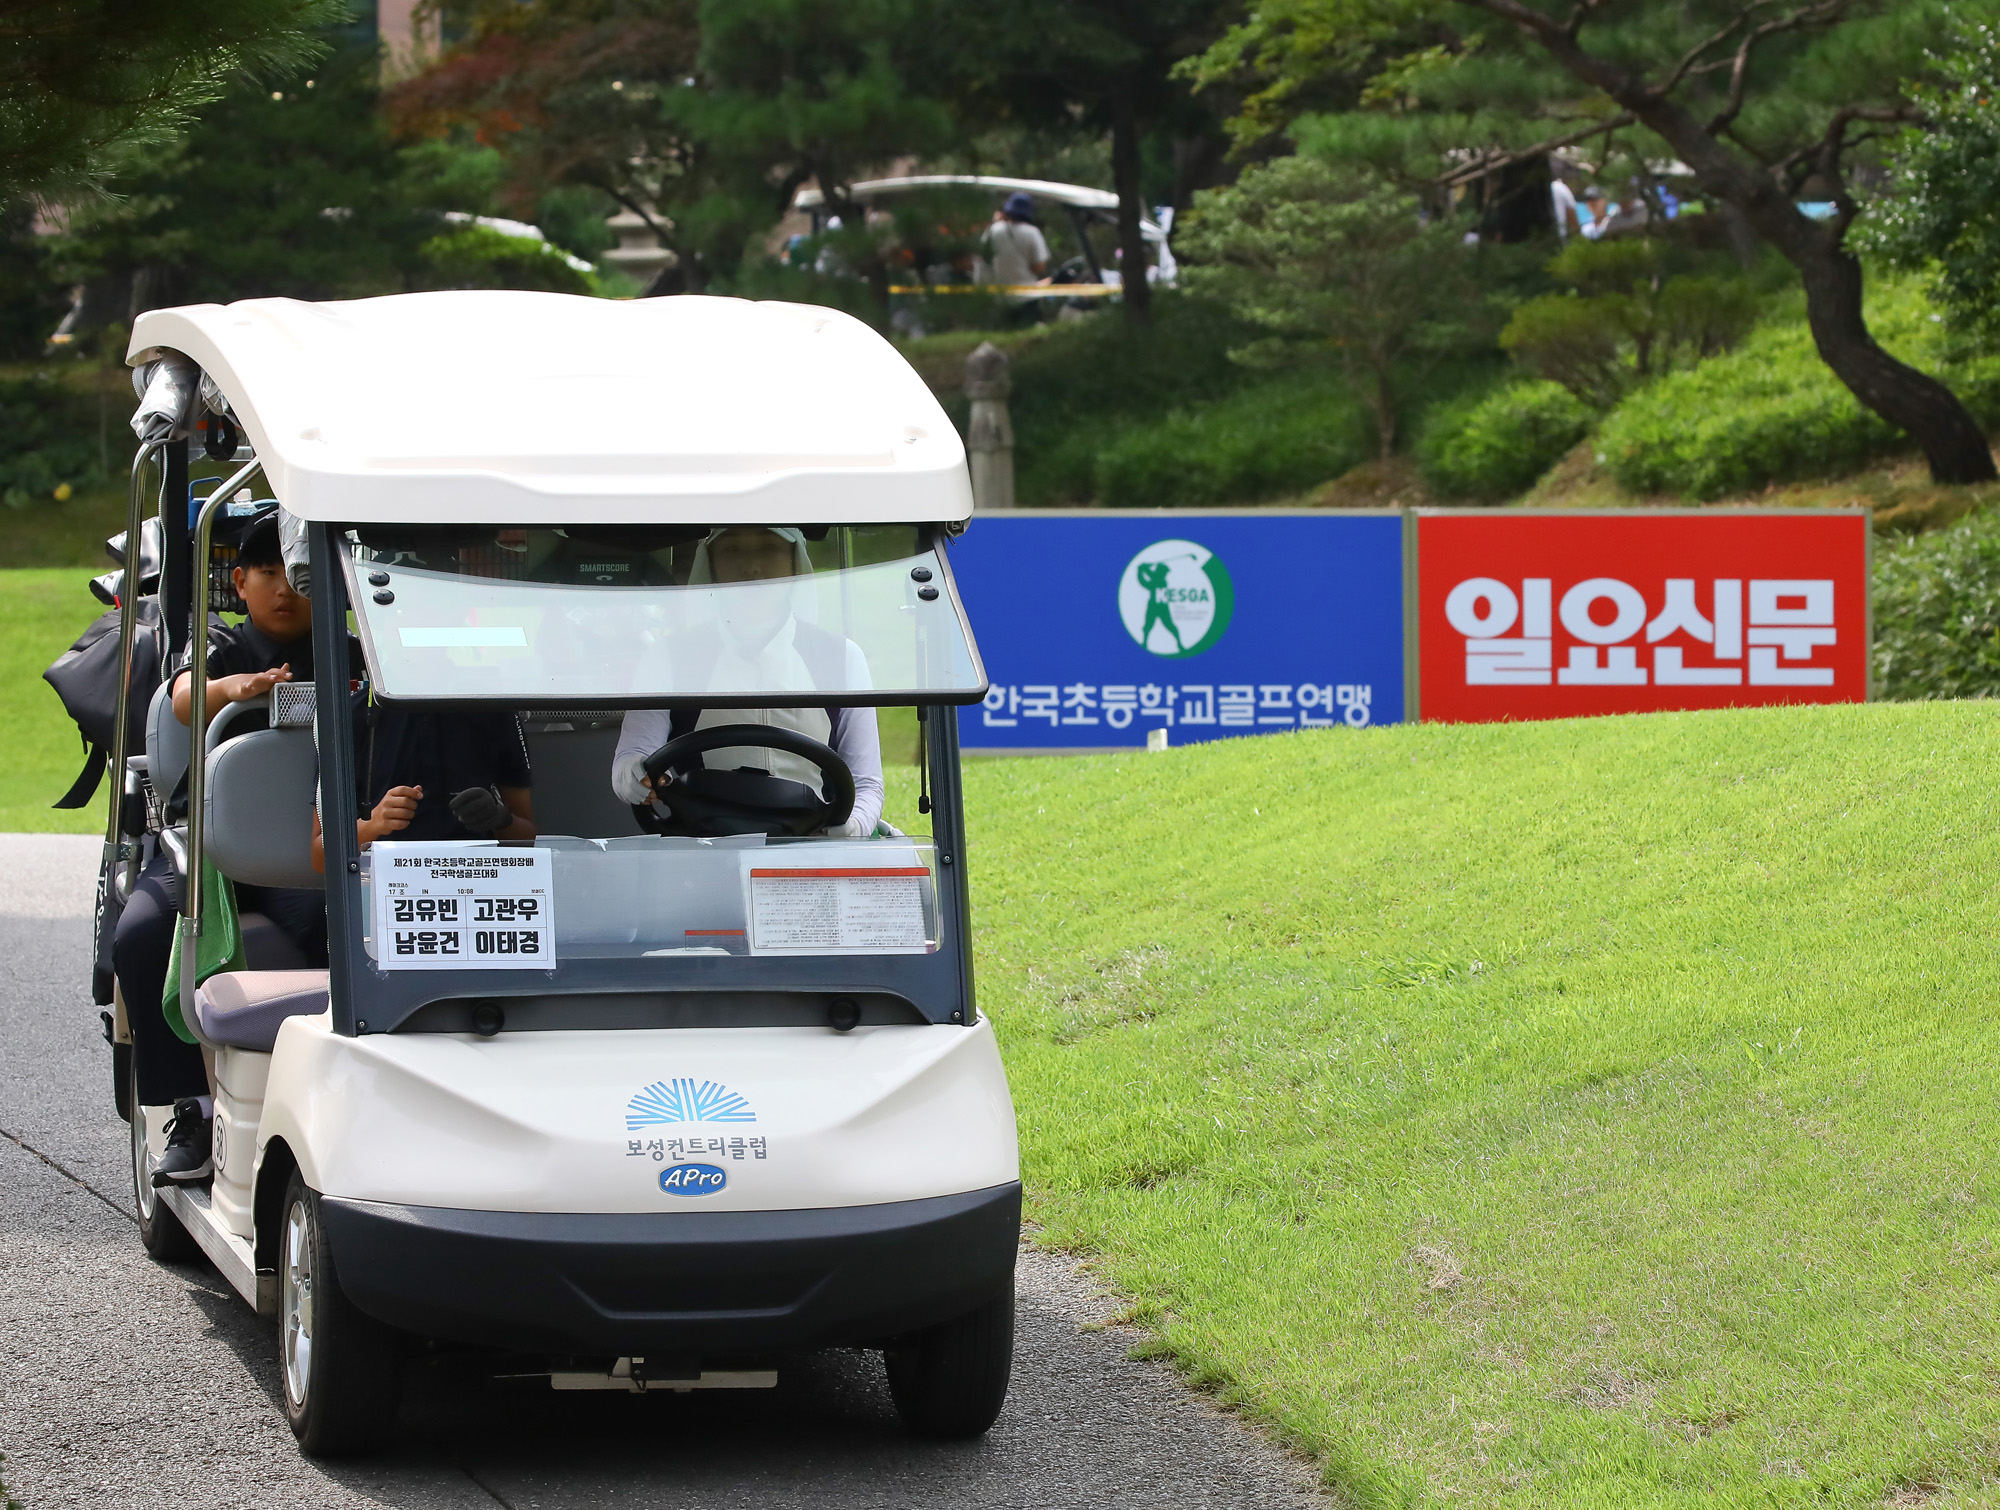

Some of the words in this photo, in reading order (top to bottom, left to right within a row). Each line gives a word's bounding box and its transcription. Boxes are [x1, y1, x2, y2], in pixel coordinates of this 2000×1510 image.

[580, 563, 629, 572] SMARTSCORE
[1445, 577, 1837, 686] 일요신문
[982, 682, 1372, 728] 한국초등학교골프연맹
[394, 857, 422, 867] 제21회
[423, 857, 534, 867] 한국초등학교골프연맹회장배
[430, 869, 498, 879] 전국학생골프대회
[394, 899, 458, 922] 김유빈
[473, 898, 539, 922] 고관우
[395, 931, 460, 955] 남윤건
[475, 930, 540, 954] 이태경
[626, 1136, 767, 1161] 보성컨트리클럽
[664, 1168, 723, 1187] APro
